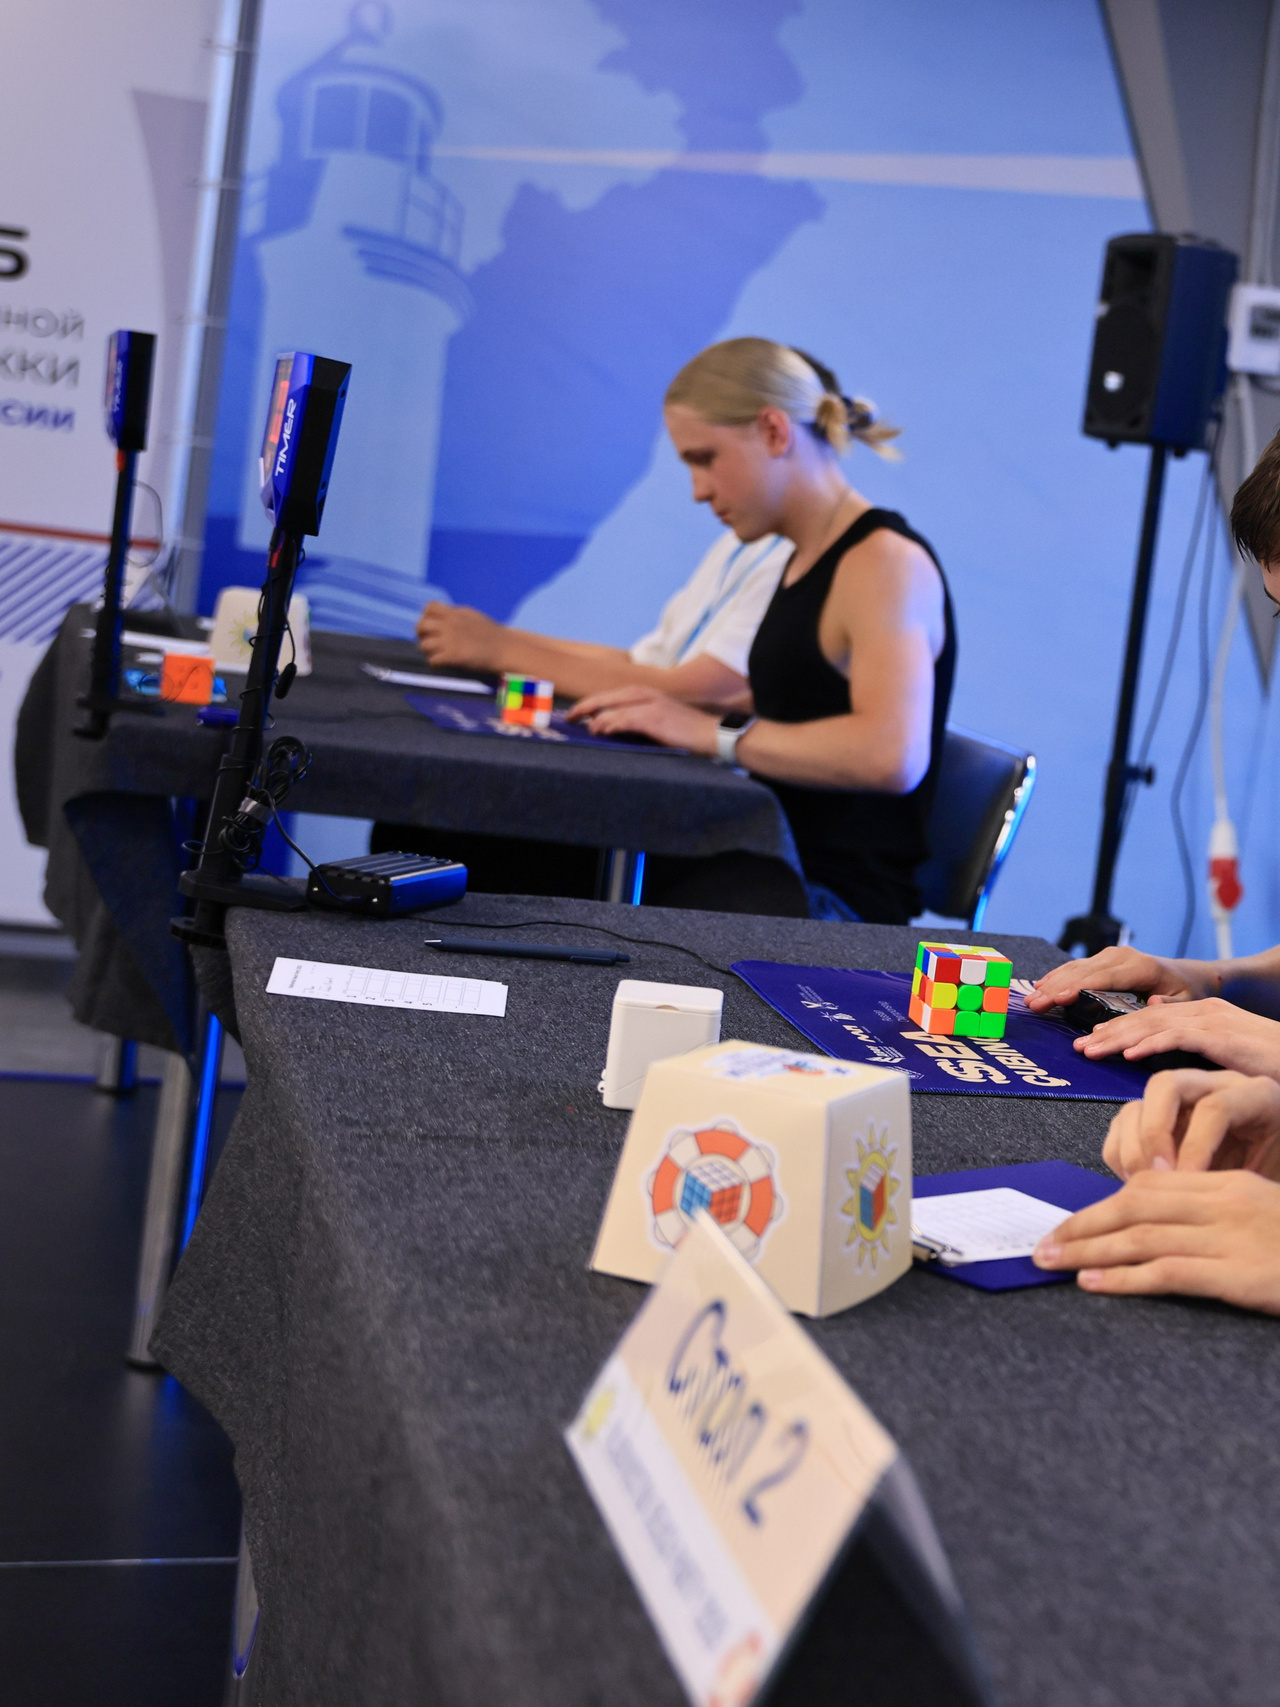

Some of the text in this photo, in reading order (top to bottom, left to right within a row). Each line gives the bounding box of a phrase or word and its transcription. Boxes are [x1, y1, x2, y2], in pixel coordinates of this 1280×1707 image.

[275, 398, 297, 476] TIMER
[899, 1031, 1011, 1084] SEA
[742, 1417, 810, 1529] 2
